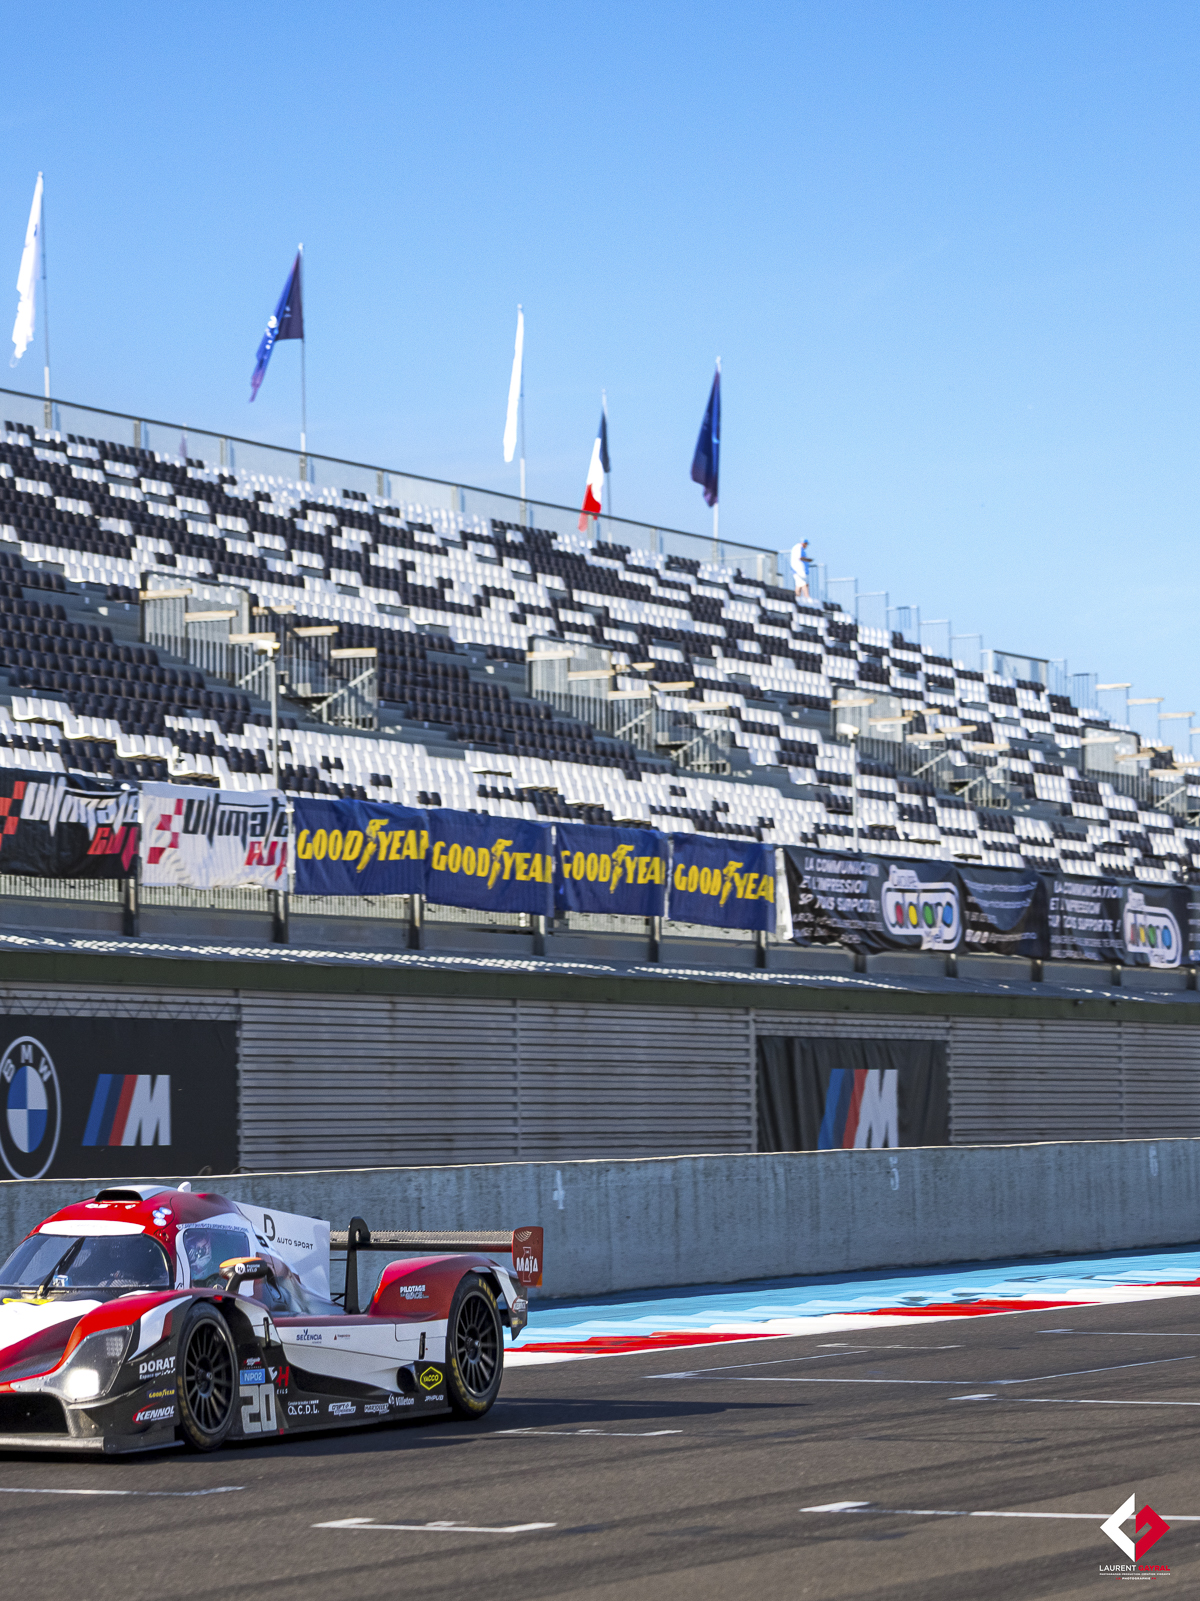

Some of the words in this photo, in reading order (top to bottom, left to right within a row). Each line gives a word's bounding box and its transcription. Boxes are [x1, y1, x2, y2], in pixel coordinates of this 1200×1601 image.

[1, 1044, 52, 1083] BMW
[277, 1237, 292, 1246] AUTO
[294, 1240, 314, 1250] SPORT
[400, 1284, 426, 1293] PILOTAGE
[139, 1356, 176, 1374] DORAT
[244, 1372, 263, 1382] NP02
[135, 1405, 175, 1422] KENNOL
[239, 1383, 277, 1434] 20
